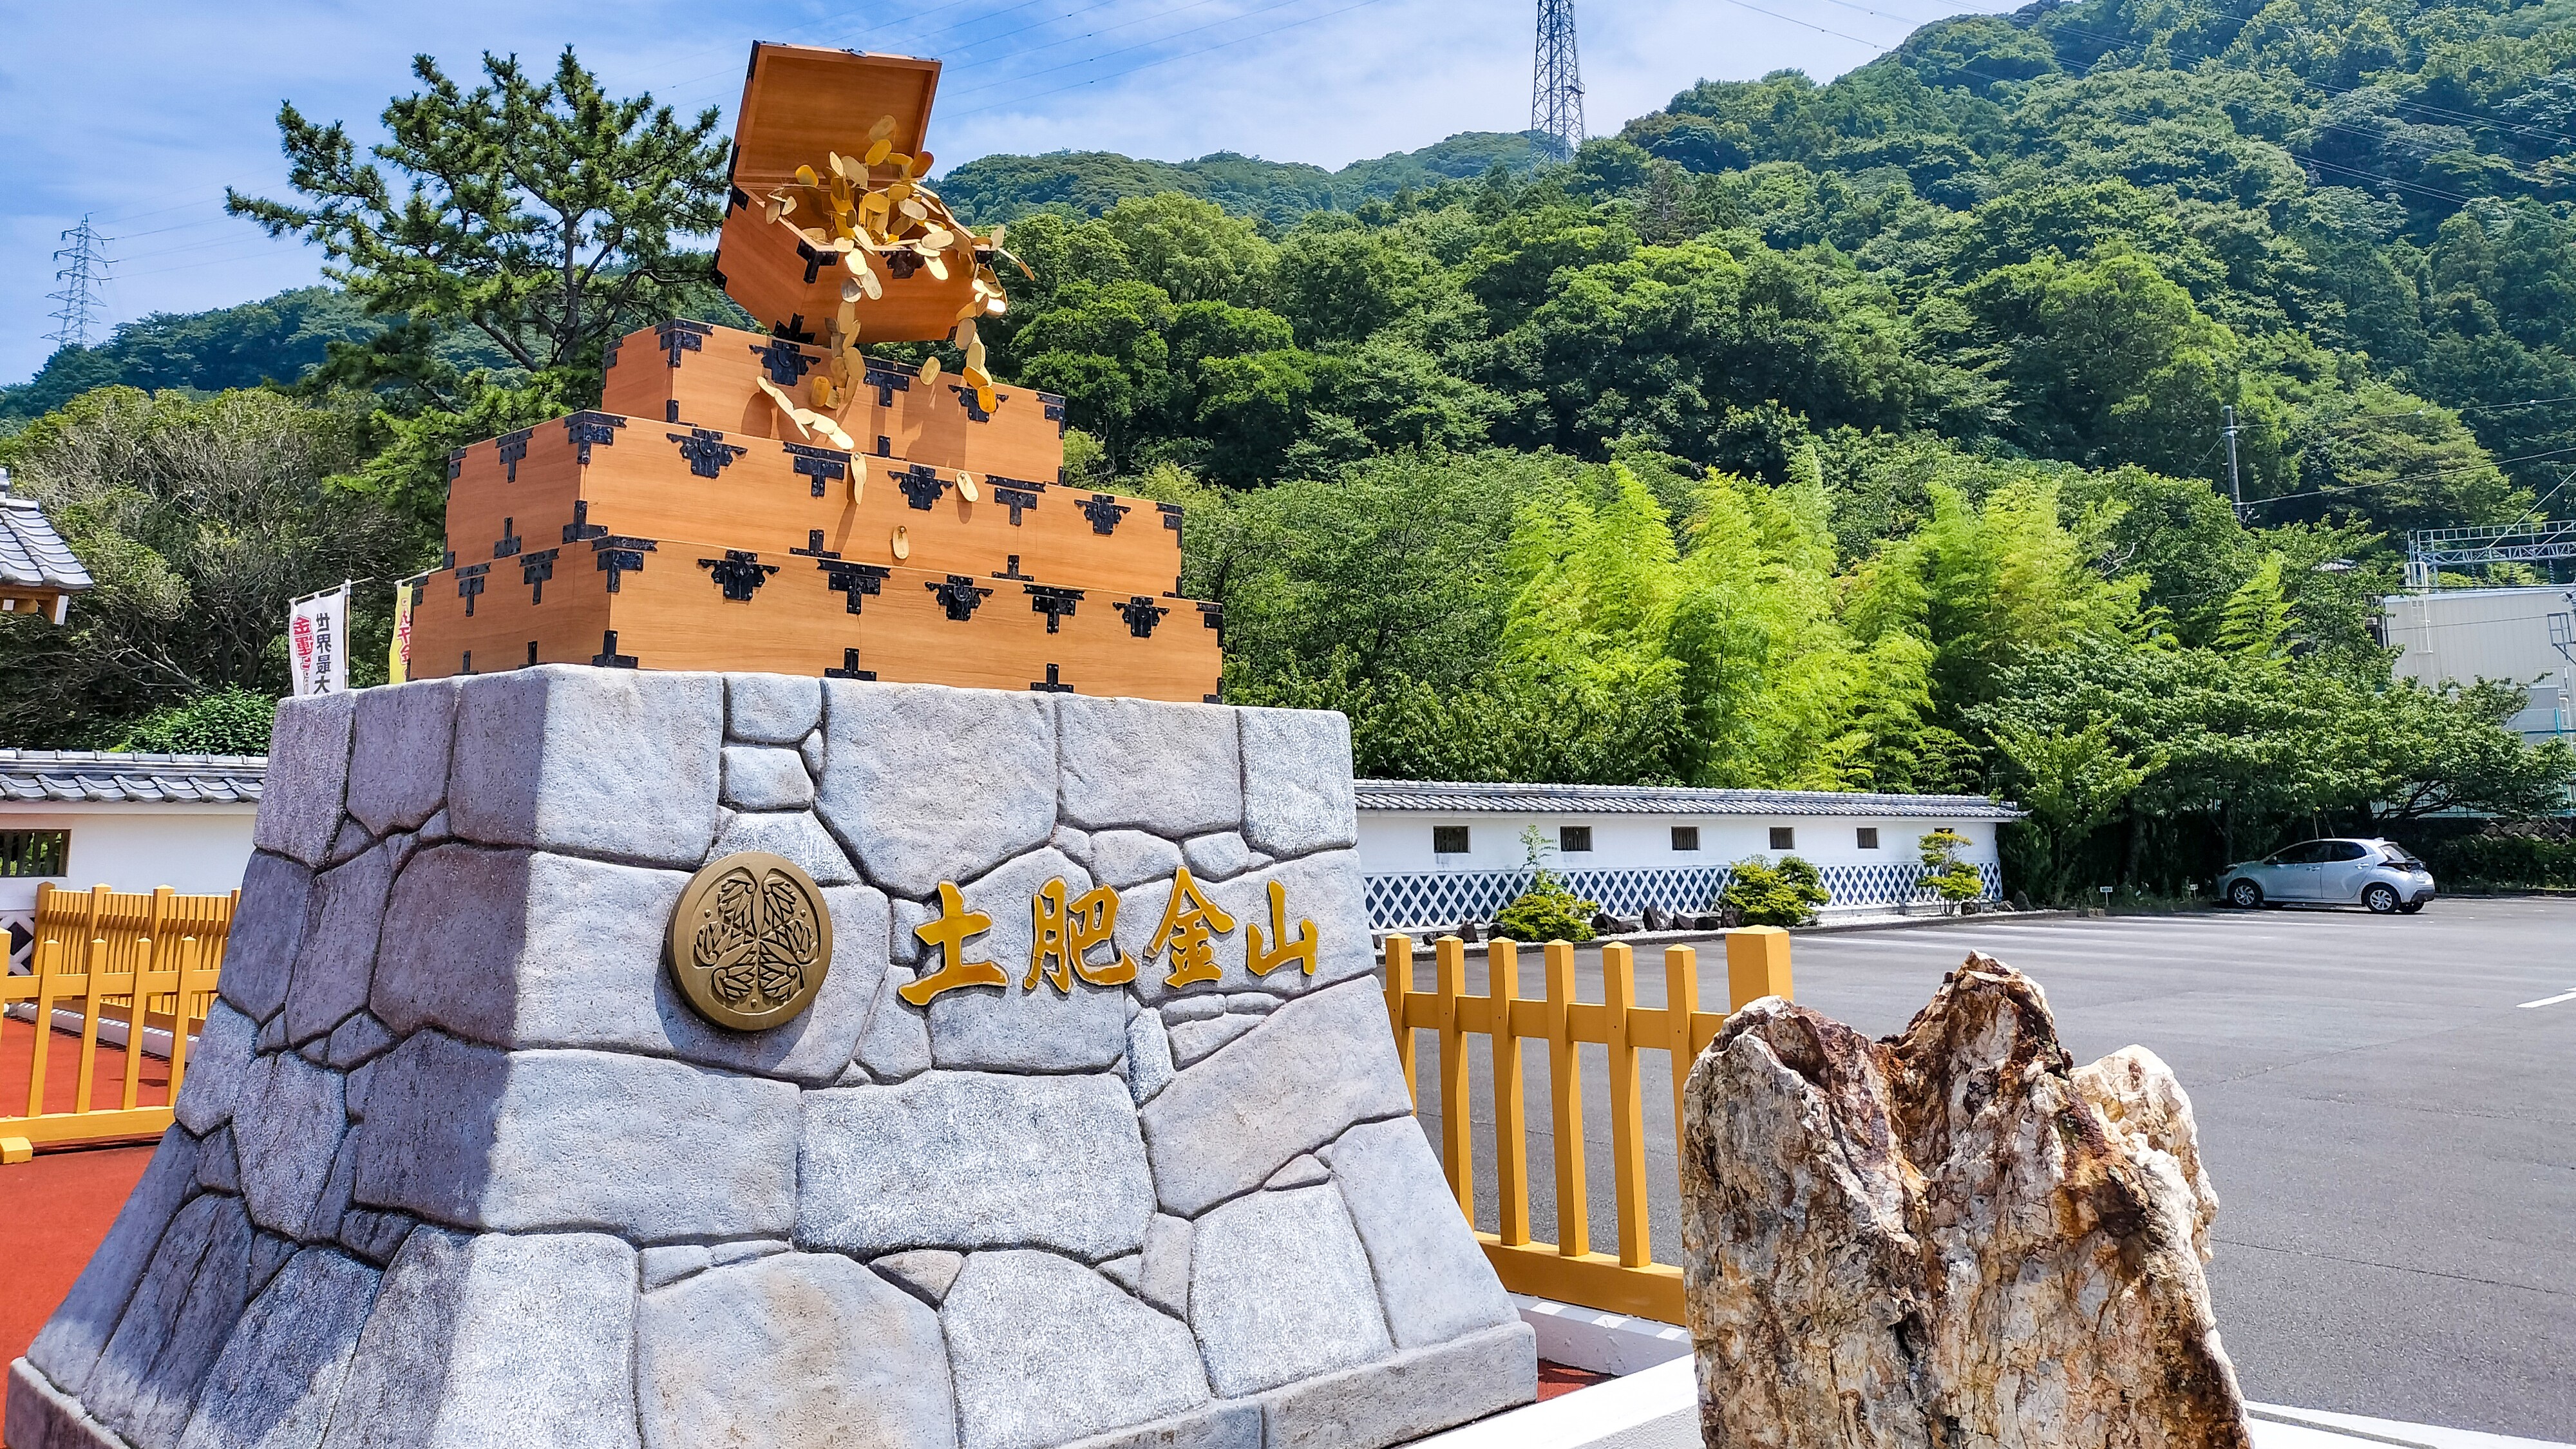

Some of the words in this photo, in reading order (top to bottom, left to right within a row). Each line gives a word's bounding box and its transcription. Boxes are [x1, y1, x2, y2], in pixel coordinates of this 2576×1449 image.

[314, 612, 332, 695] 世界最大
[898, 865, 1319, 1006] 土肥金山
